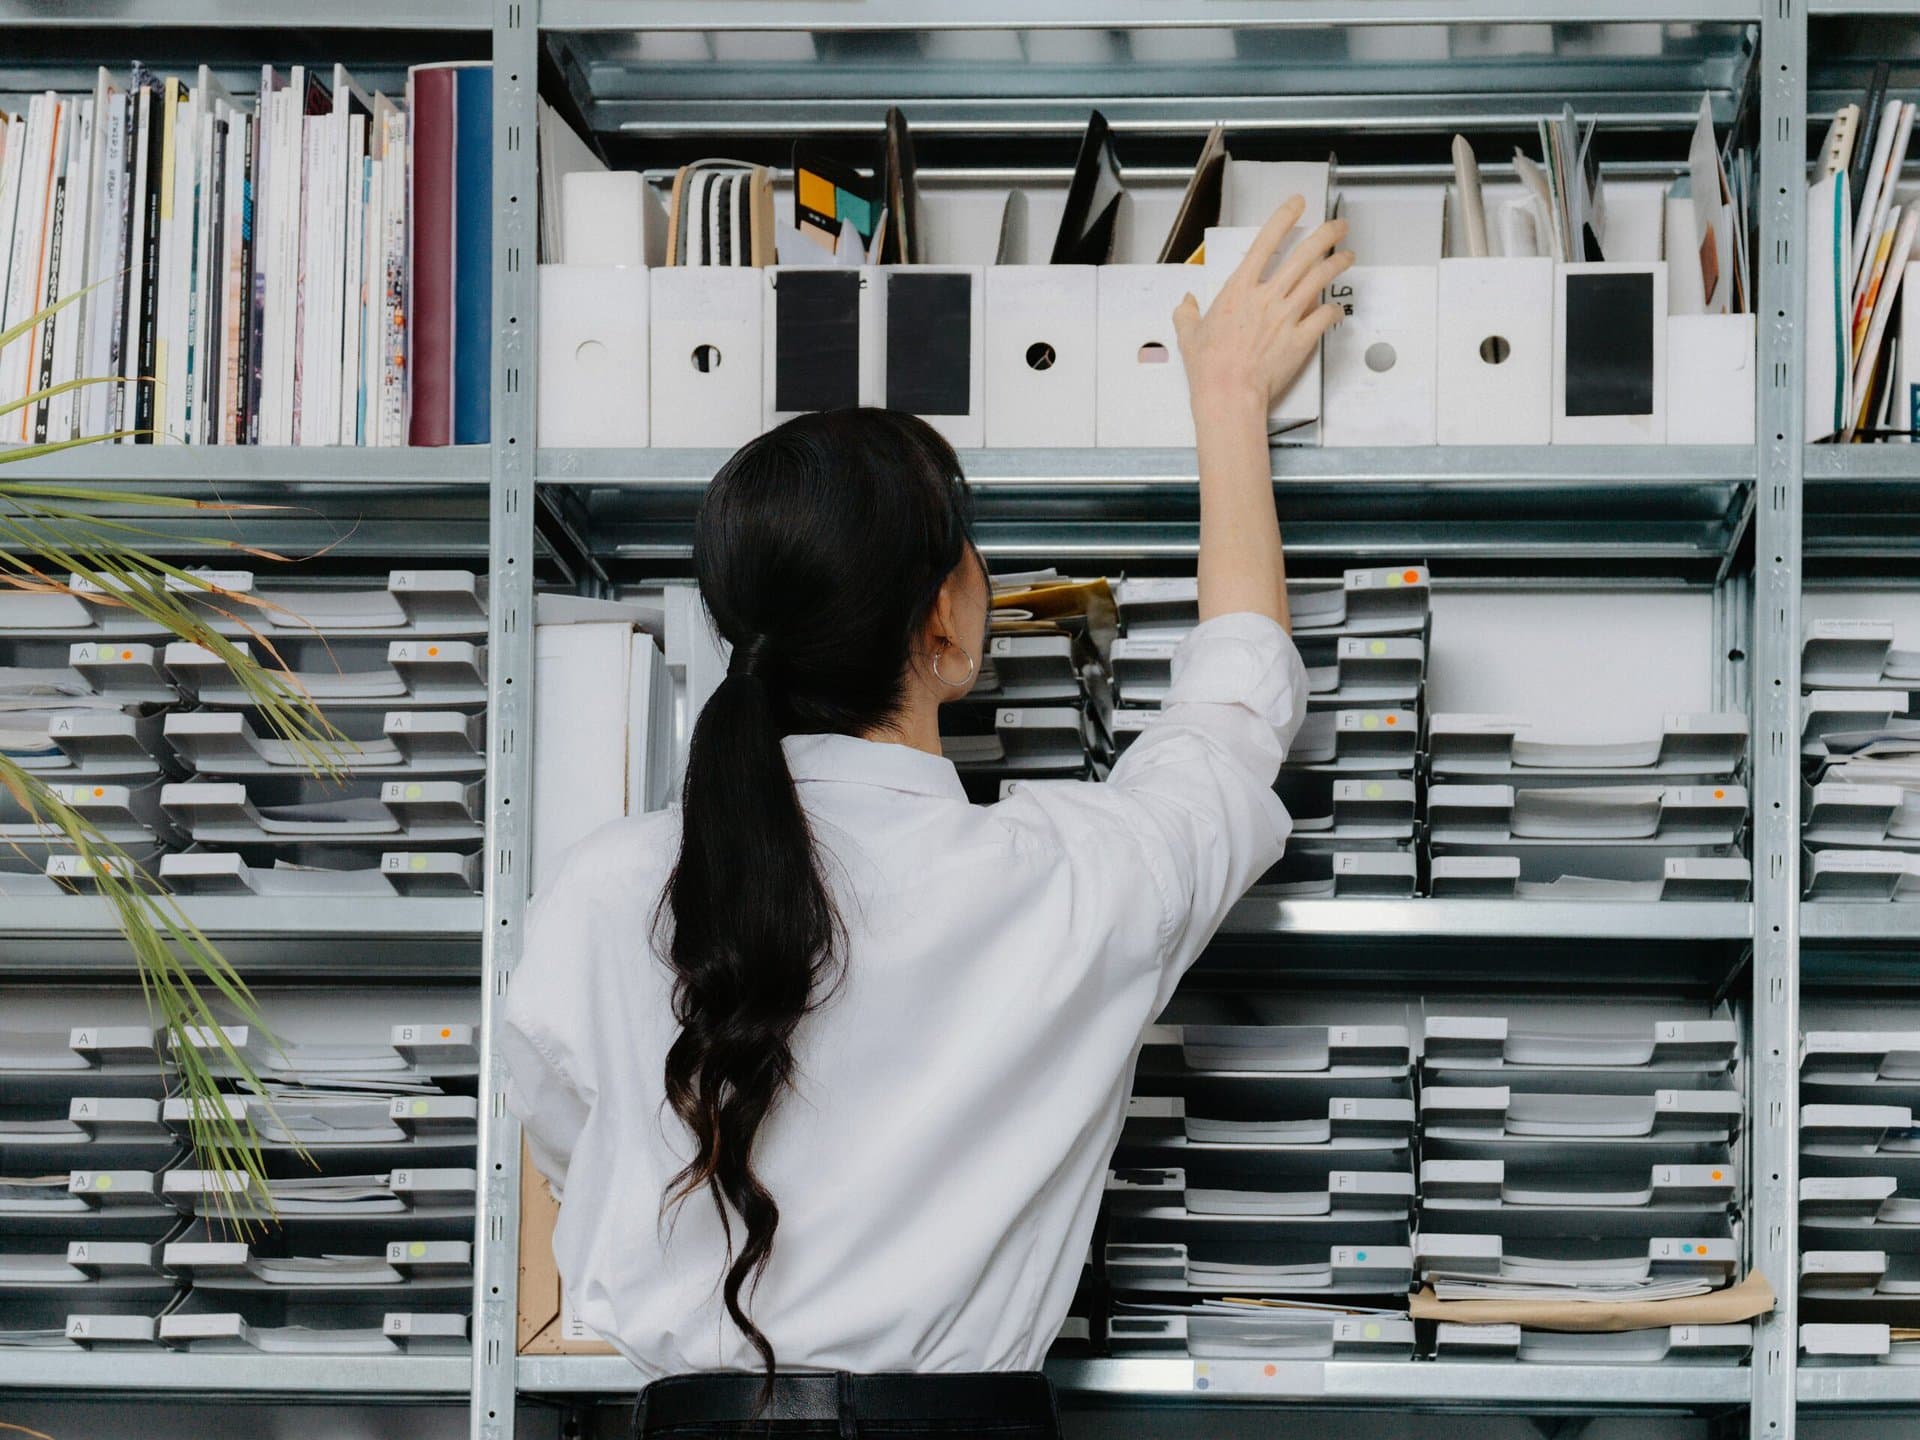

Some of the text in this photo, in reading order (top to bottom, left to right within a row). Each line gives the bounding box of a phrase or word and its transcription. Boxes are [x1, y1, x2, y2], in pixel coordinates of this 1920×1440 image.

[397, 575, 407, 585] A
[1355, 576, 1362, 585] F
[997, 640, 1005, 650] C
[1348, 643, 1357, 653] F
[80, 648, 89, 658] A
[398, 647, 408, 657] A
[394, 717, 403, 727] A
[1004, 713, 1014, 723] C
[1344, 716, 1353, 726] F
[59, 720, 69, 730] A
[391, 786, 399, 795] B
[1344, 785, 1352, 795] F
[56, 861, 66, 870] A
[390, 858, 399, 868] B
[1343, 858, 1351, 868] F
[403, 1029, 412, 1040] B
[1340, 1032, 1348, 1042] F
[1667, 1028, 1675, 1038] J
[79, 1033, 88, 1044] A
[1666, 1095, 1673, 1106] J
[79, 1103, 89, 1113] A
[396, 1101, 404, 1112] B
[1344, 1104, 1352, 1114] F
[76, 1176, 85, 1186] A
[399, 1173, 406, 1184] B
[1339, 1176, 1347, 1186] F
[1663, 1171, 1671, 1182] J
[77, 1246, 85, 1256] A
[393, 1247, 400, 1257] B
[1662, 1244, 1670, 1255] J
[1339, 1251, 1347, 1262] F
[73, 1322, 83, 1332] A
[394, 1320, 401, 1329] B
[1342, 1325, 1350, 1335] F
[1681, 1329, 1689, 1340] J
